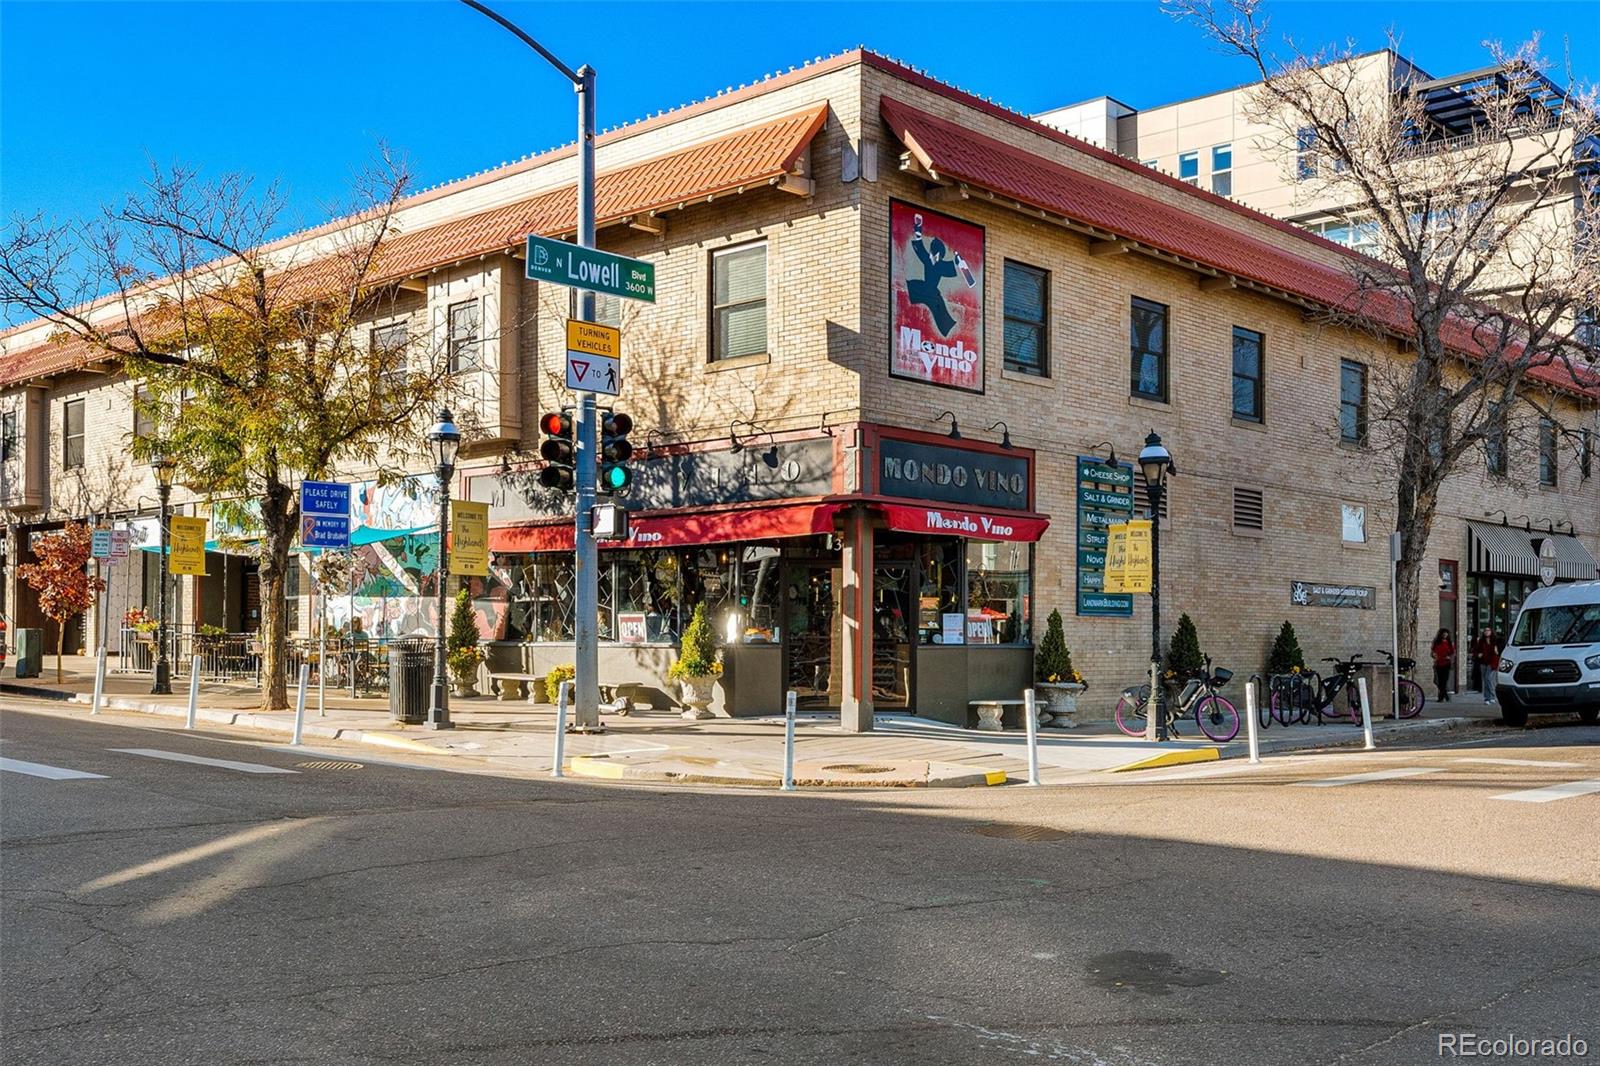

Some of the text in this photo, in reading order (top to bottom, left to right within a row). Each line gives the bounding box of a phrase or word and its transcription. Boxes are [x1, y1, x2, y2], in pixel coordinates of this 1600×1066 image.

[531, 265, 552, 273] DENVER
[556, 252, 619, 288] N Lowell
[631, 270, 647, 281] Blvd
[625, 282, 653, 295] 3600 W
[579, 326, 611, 340] TURNING
[577, 339, 612, 353] VEHICLES
[900, 325, 977, 363] Mondo
[919, 351, 972, 376] Vino
[592, 369, 602, 379] TO
[884, 456, 1024, 495] MONDO VINO
[305, 488, 348, 499] PLEASE DRIVE
[1101, 495, 1106, 503] &
[315, 500, 338, 509] SAFELY
[457, 512, 477, 520] WELCOME
[927, 511, 1013, 536] Mondo Vino
[315, 530, 326, 539] Brad
[628, 526, 662, 543] Vino
[454, 535, 484, 549] Highlands
[621, 621, 644, 638] OPEN
